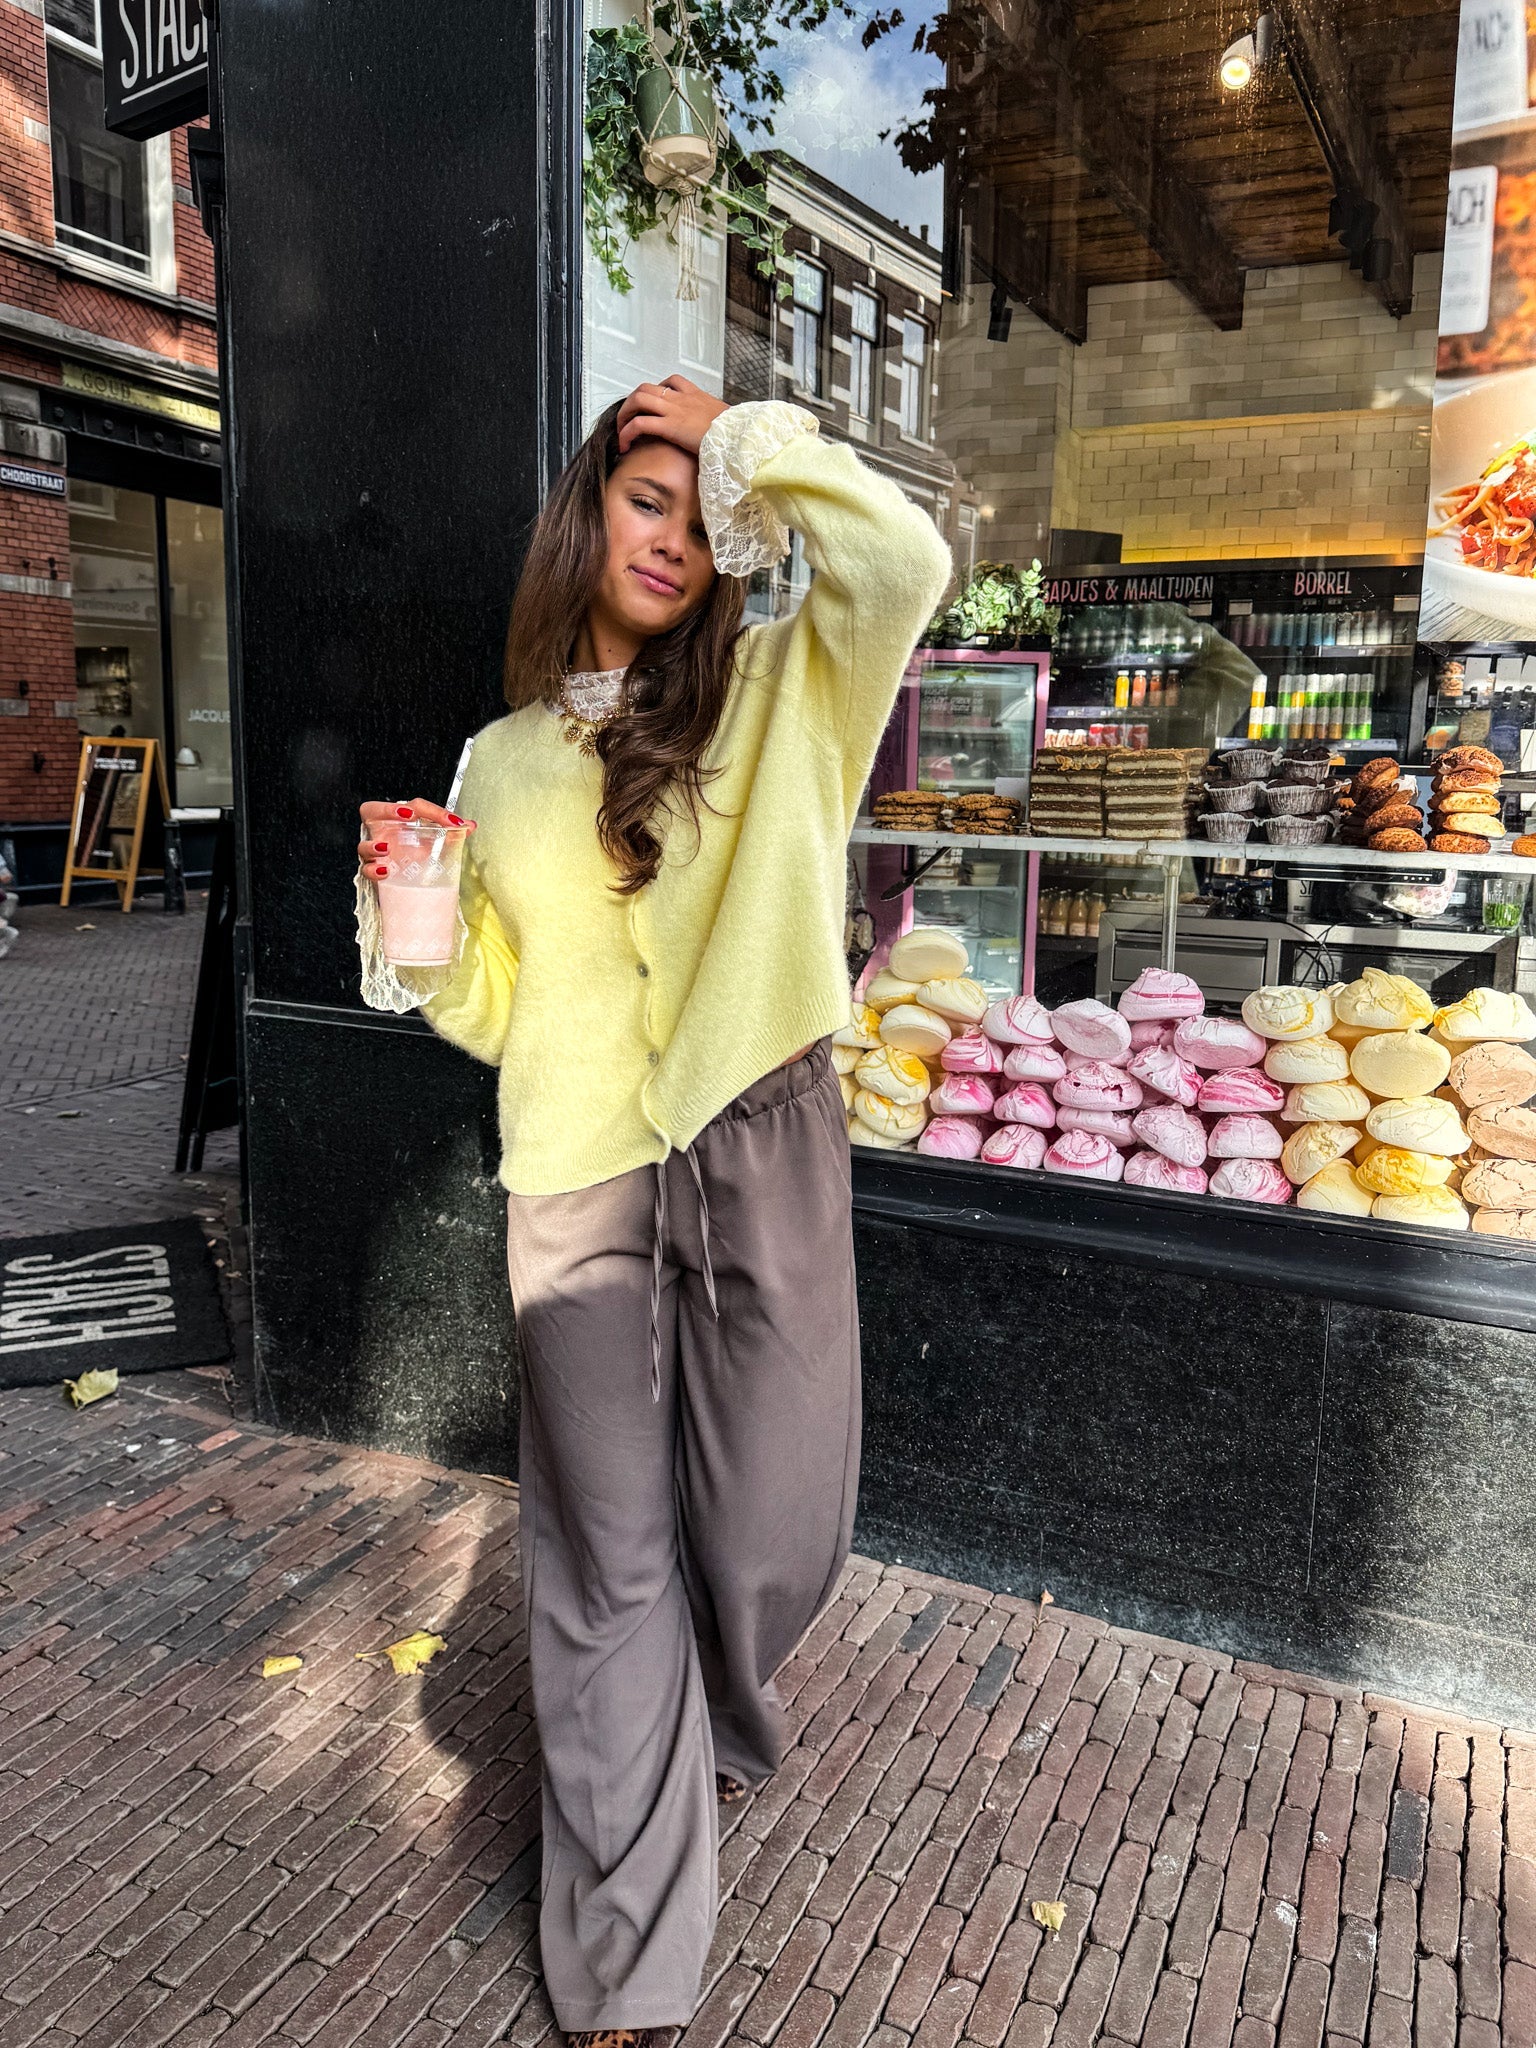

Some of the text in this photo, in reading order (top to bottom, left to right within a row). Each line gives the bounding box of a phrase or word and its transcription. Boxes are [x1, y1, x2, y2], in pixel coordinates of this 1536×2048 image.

[119, 0, 208, 89] STAC
[0, 467, 64, 491] CHOORSTRAAT
[1105, 579, 1119, 601] &
[1294, 571, 1351, 596] BORREL
[0, 1244, 177, 1354] STACH
